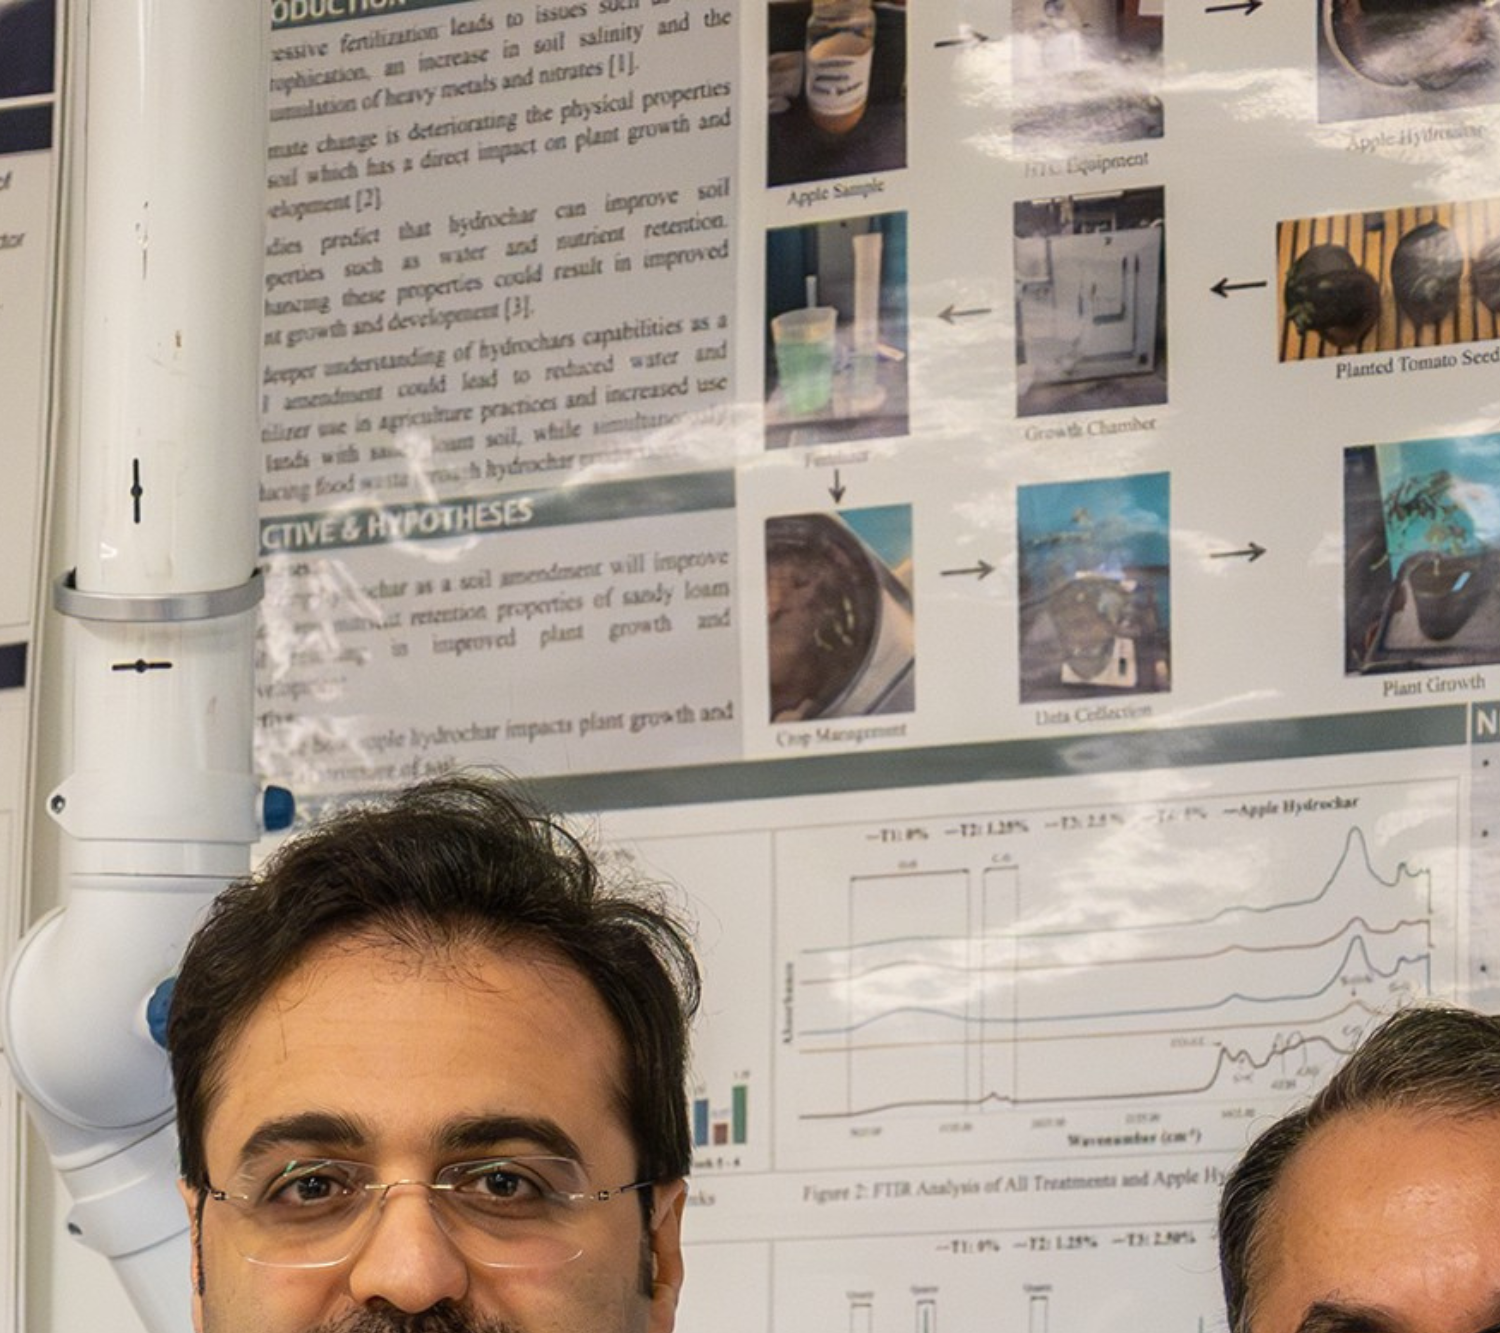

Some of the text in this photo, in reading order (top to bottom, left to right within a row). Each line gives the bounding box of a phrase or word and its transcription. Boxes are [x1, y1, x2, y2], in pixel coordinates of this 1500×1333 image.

[1335, 356, 1395, 381] Planted
[1399, 350, 1458, 374] Tomato
[341, 518, 360, 538] &
[368, 499, 534, 538] HYPOTHESES
[1383, 672, 1486, 697] Plant Growth
